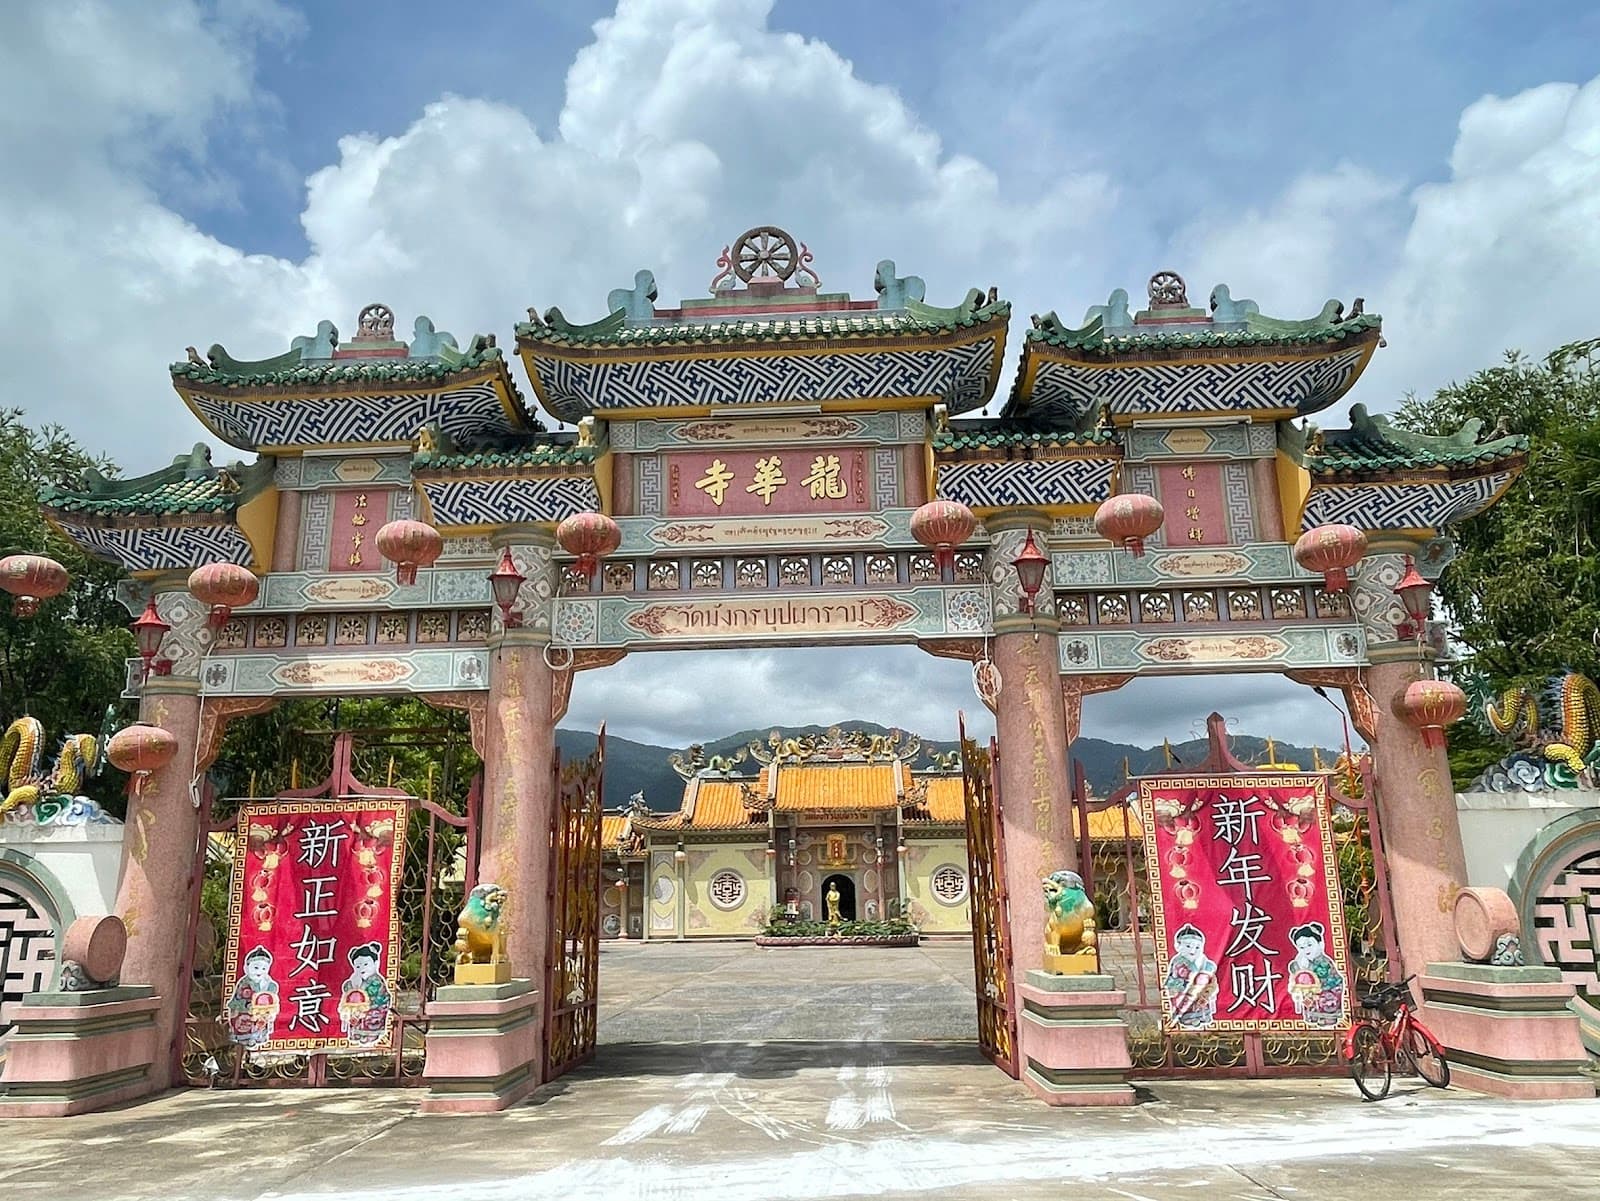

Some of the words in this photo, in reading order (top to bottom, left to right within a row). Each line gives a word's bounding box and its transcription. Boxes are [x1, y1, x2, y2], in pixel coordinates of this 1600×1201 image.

[288, 818, 349, 1034] 新正如意
[1211, 794, 1283, 1014] 新年发财
